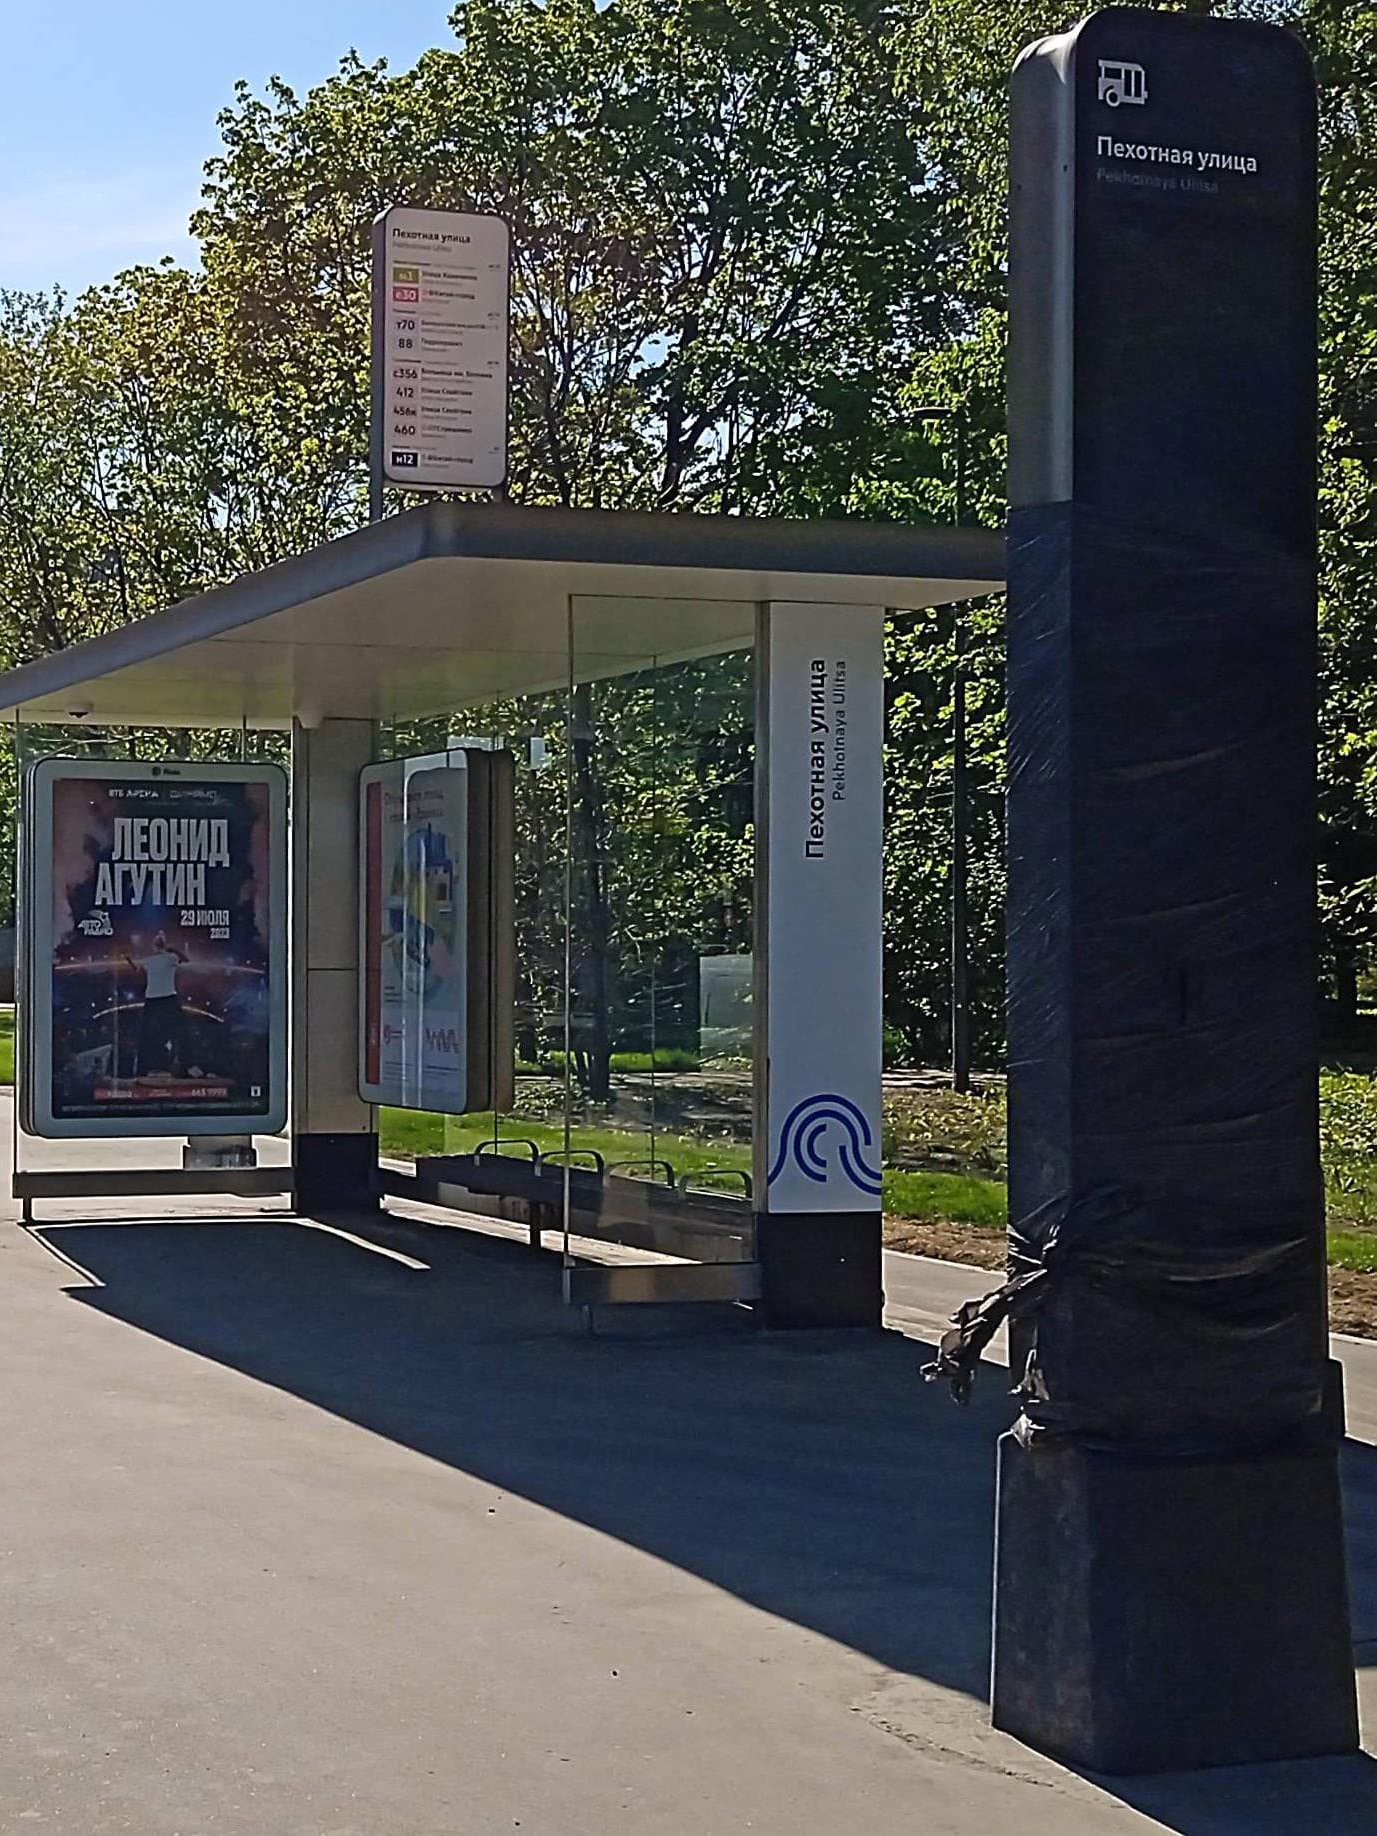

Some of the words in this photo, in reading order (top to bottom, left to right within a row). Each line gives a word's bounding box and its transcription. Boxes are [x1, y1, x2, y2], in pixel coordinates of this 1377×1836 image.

[1097, 136, 1193, 165] Пехотная
[1198, 151, 1257, 174] улица
[392, 228, 439, 240] Пехотная
[441, 234, 471, 243] улица
[398, 338, 413, 349] 88
[396, 387, 414, 398] 412
[394, 425, 416, 435] 460
[811, 660, 829, 733] улица
[833, 661, 846, 704] Ulitsa
[833, 710, 847, 801] Pekhotnaya
[805, 741, 826, 859] Пехотная
[112, 817, 229, 868] ЛЕОНИД
[94, 862, 206, 906] АГУТИН
[181, 910, 195, 926] 29
[196, 910, 230, 926] ИЮЛЯ
